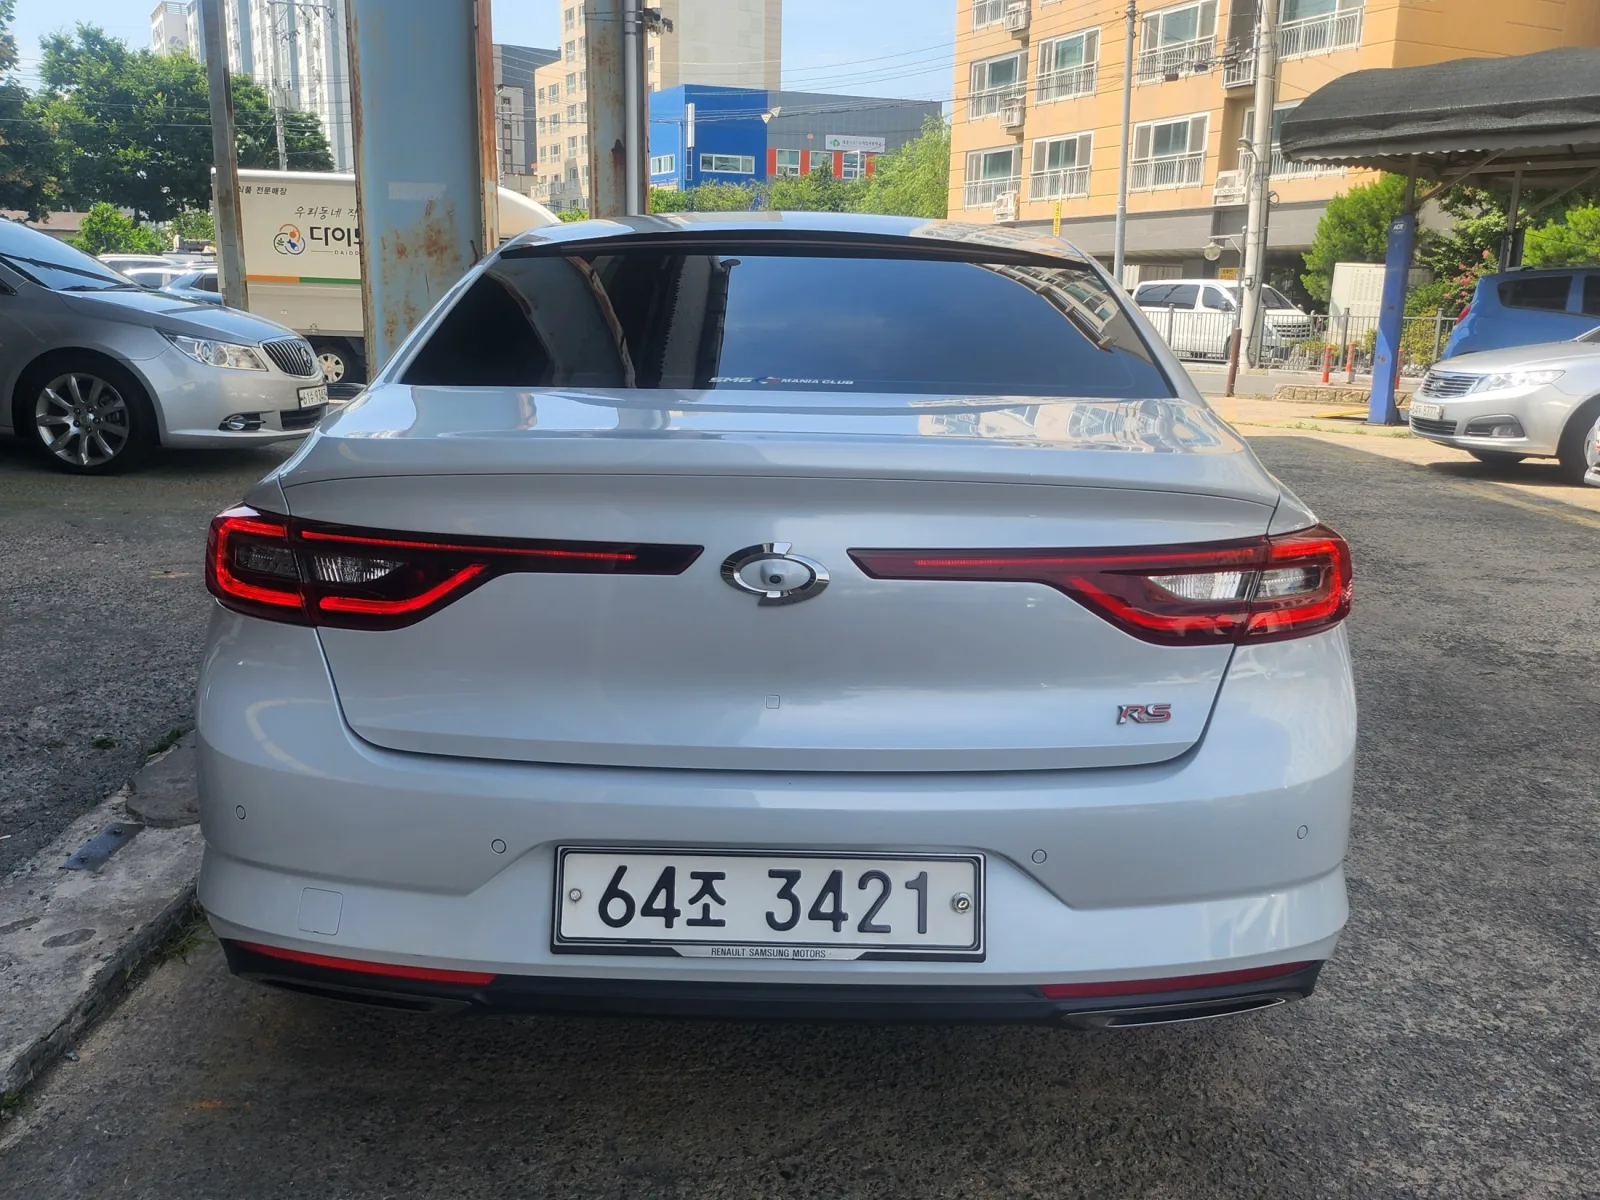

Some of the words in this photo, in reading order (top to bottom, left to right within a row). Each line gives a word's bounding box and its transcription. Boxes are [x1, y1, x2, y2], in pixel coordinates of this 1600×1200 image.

[256, 186, 288, 196] 전문매장
[294, 206, 342, 220] 우리동네
[1116, 703, 1172, 726] RS
[597, 865, 727, 929] 64조
[765, 868, 928, 934] 3421
[711, 947, 746, 957] RENAULT
[749, 948, 790, 958] SAMSUNG
[793, 949, 826, 959] MOTORS
